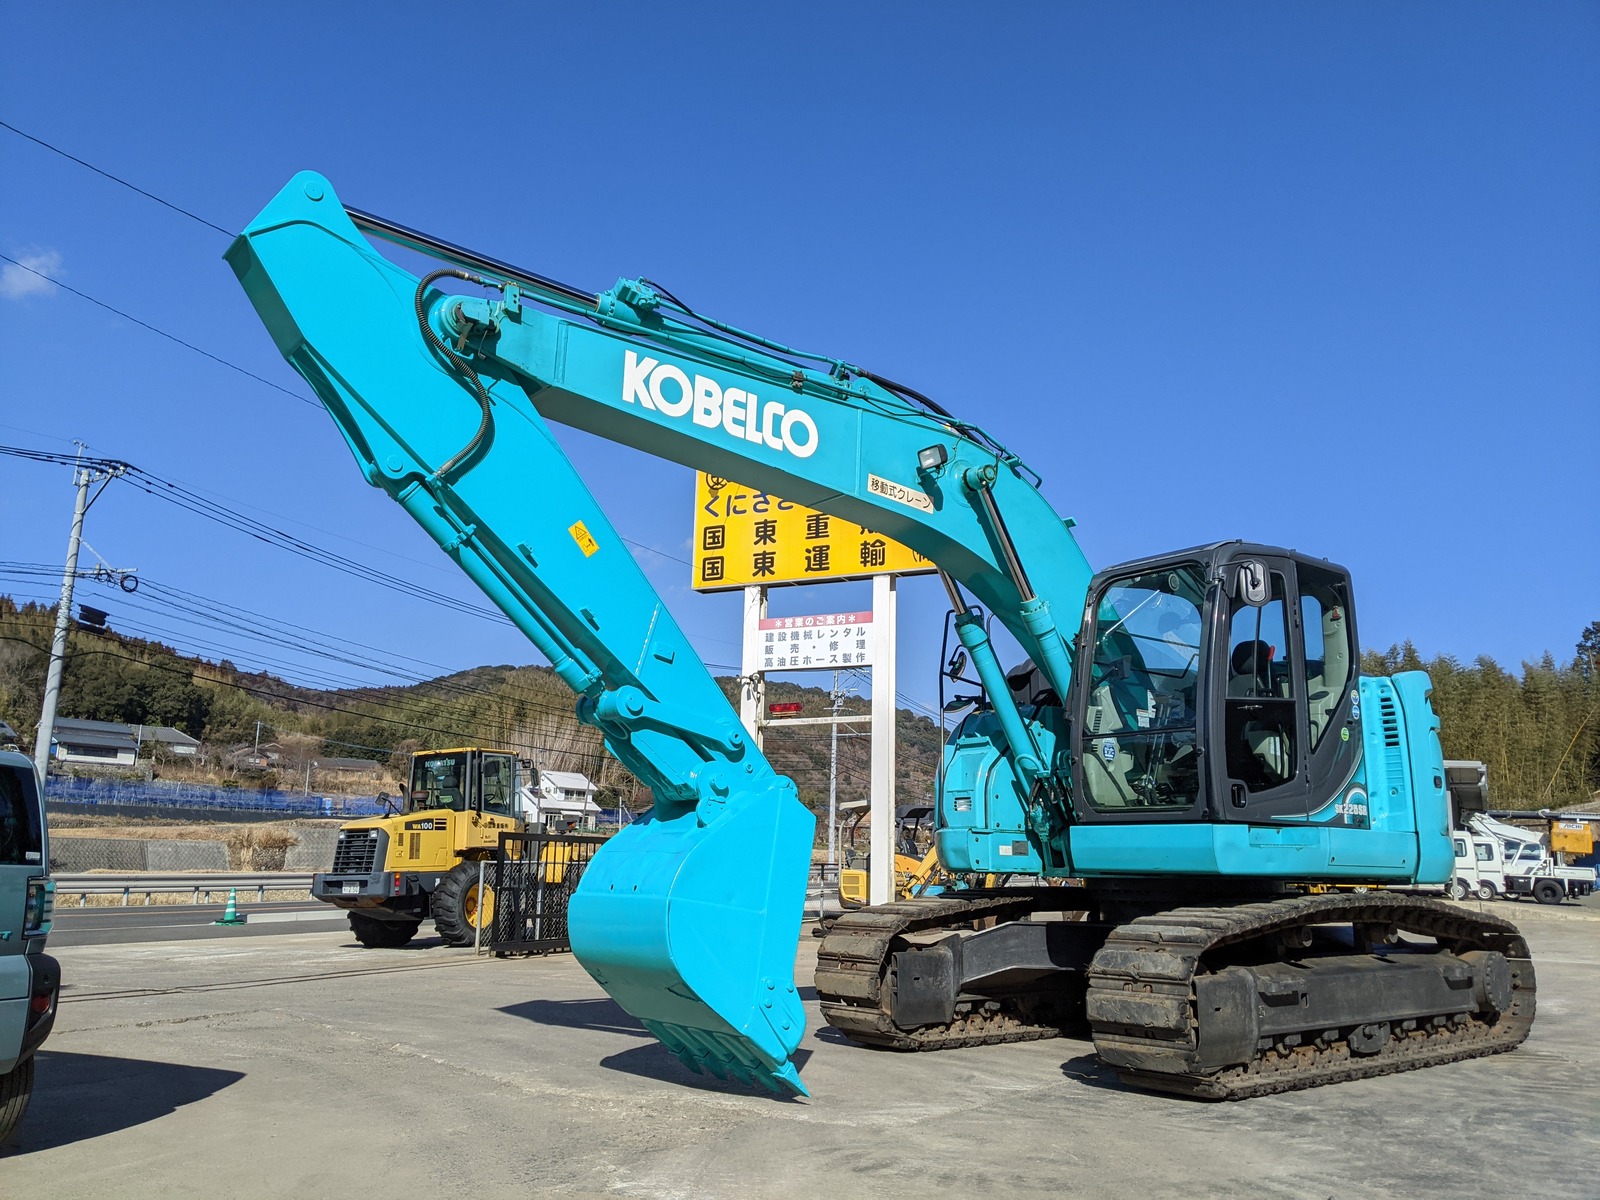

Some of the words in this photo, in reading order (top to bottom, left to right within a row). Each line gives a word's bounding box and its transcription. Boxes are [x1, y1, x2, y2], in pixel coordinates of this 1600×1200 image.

[622, 349, 819, 458] KOBELCO
[871, 478, 931, 509] 移動式クレーン
[765, 627, 866, 643] 建設機械レンタル
[764, 652, 866, 668] 高油圧ホース製作
[411, 822, 433, 830] WA100
